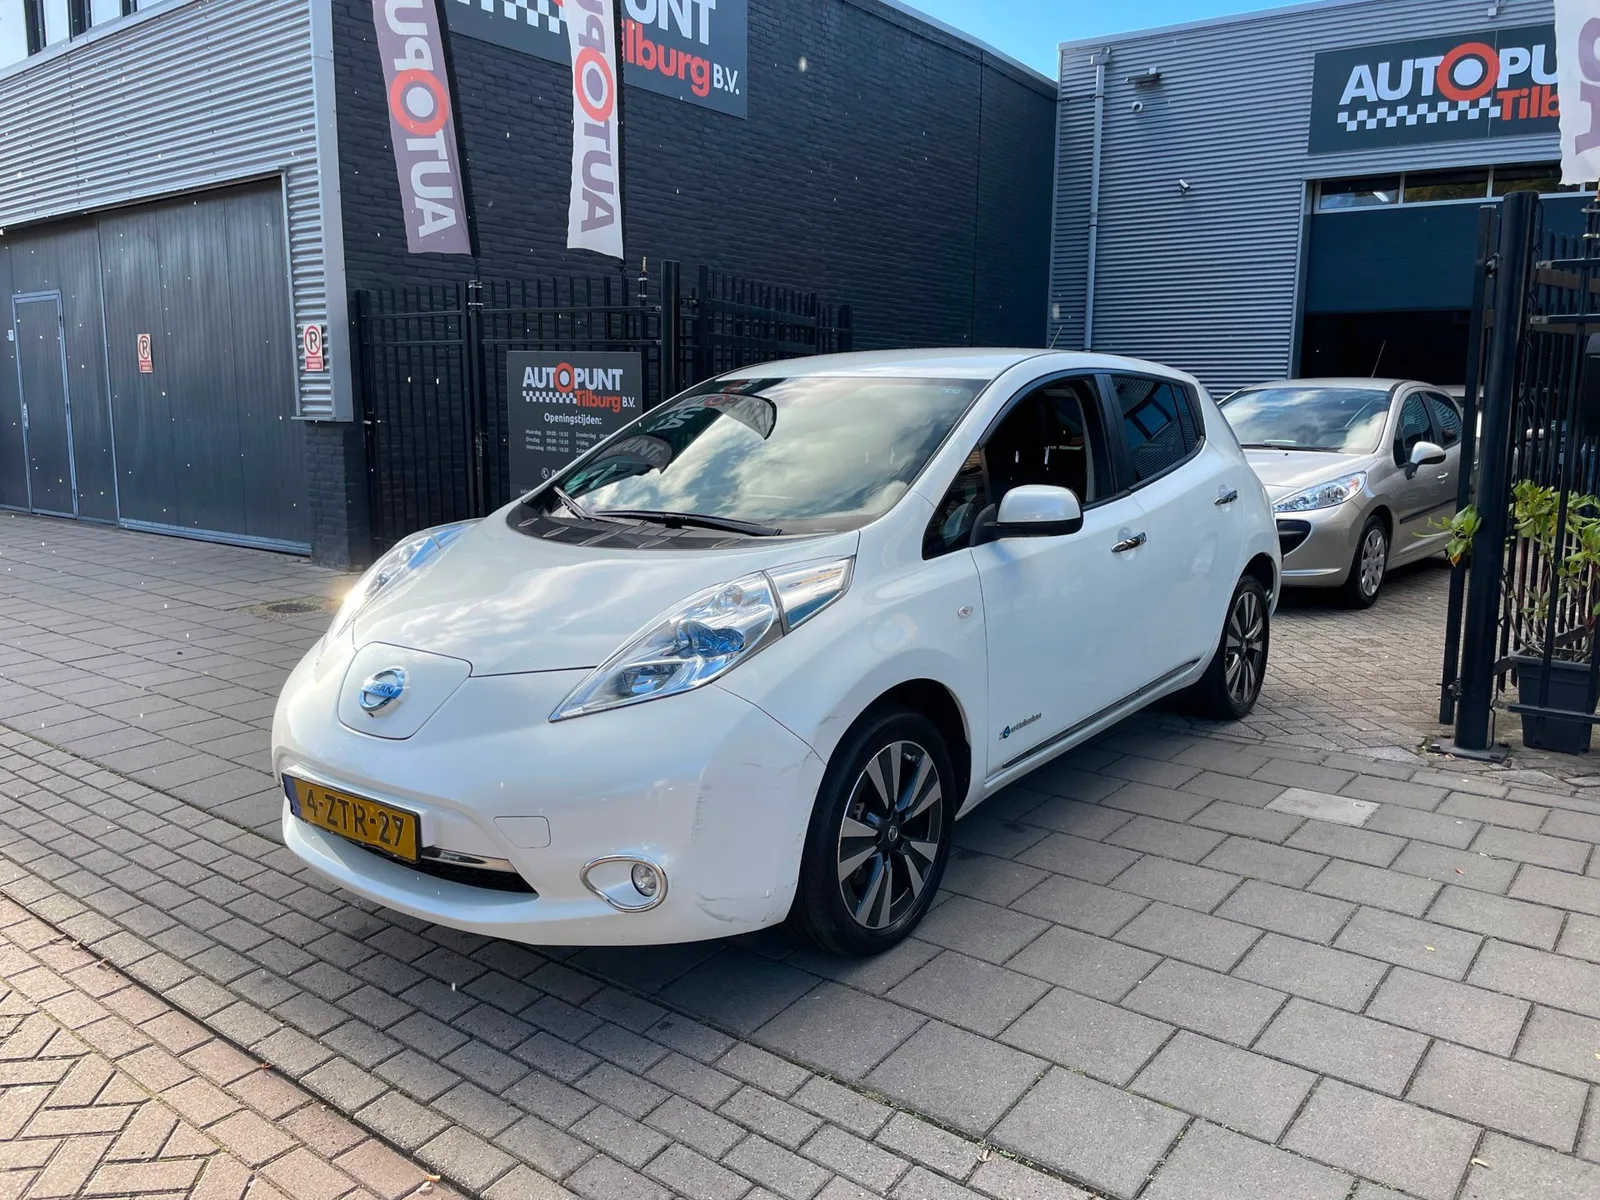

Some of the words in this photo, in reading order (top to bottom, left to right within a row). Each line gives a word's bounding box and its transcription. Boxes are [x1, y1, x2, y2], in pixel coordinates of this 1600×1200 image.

[621, 18, 710, 97] lburg
[713, 63, 740, 95] B.V.
[1339, 42, 1558, 105] AUTOPU
[1497, 84, 1560, 121] Tilb
[522, 362, 623, 393] AUTOPUNT
[544, 412, 602, 426] Openingstijden:
[574, 390, 622, 413] Tilburg
[622, 396, 636, 408] B.V.
[306, 788, 405, 848] 4-ZTR-27
